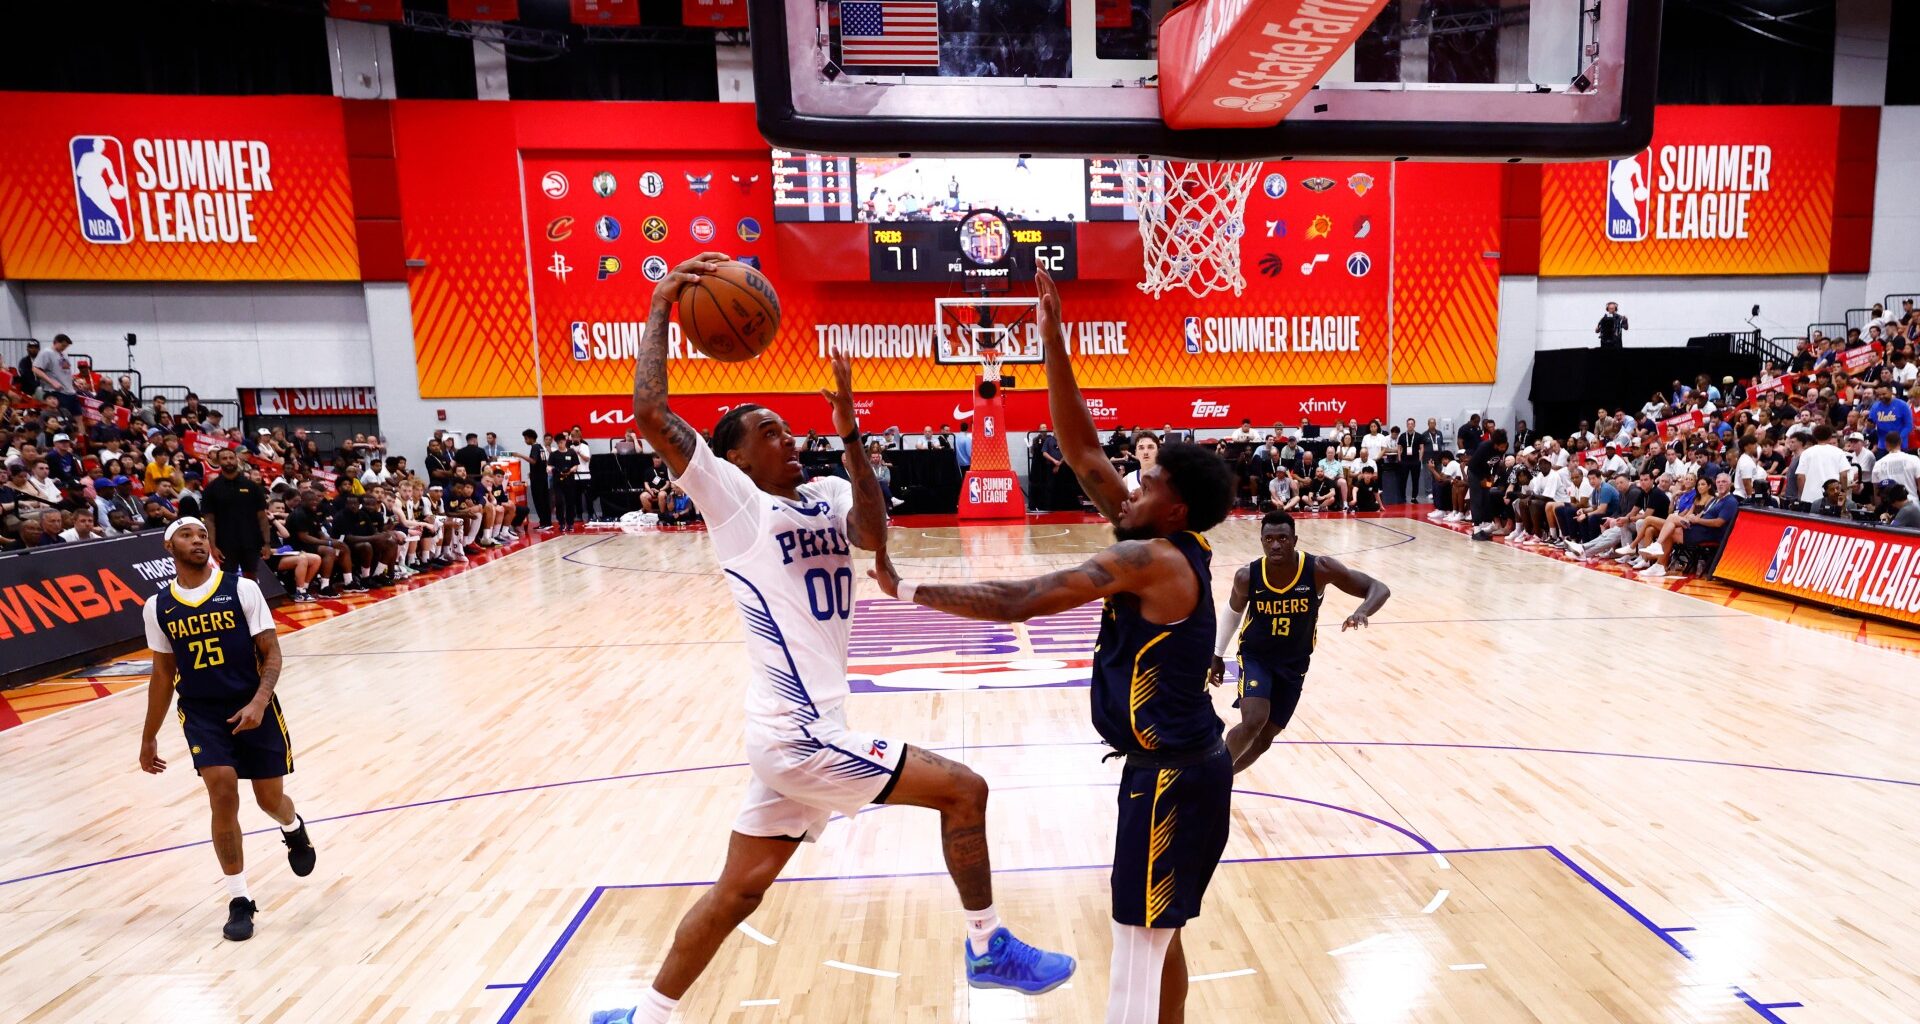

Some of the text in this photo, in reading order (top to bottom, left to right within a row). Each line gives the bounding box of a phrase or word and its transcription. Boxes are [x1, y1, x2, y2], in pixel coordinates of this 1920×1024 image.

[133, 138, 273, 191] SUMMER
[825, 161, 834, 172] 2
[840, 161, 847, 172] 1
[1658, 144, 1772, 192] SUMMER
[811, 176, 819, 188] 2
[826, 176, 835, 188] 2
[812, 192, 820, 203] 2
[827, 192, 836, 203] 3
[88, 219, 115, 236] NBA
[138, 191, 258, 243] LEAGUE
[1612, 219, 1633, 236] NBA
[1655, 193, 1751, 240] LEAGUE
[873, 230, 902, 244] 76ERS
[887, 246, 917, 271] 71
[976, 268, 1009, 277] TISSOT
[592, 322, 683, 360] SUMR
[815, 322, 952, 359] TOMORROW'S
[957, 322, 1020, 357] STRS
[1079, 320, 1129, 356] HERE
[1204, 316, 1360, 353] SUMMER LEAGUE
[294, 387, 377, 410] SUMMER
[1299, 397, 1347, 415] xfinity
[982, 477, 1013, 491] SUMMER
[982, 490, 1008, 503] LEAGUE
[775, 527, 850, 565] PHIL
[132, 556, 177, 581] THURS
[1781, 529, 1876, 600] SUMMER
[804, 567, 852, 621] 00
[1256, 598, 1309, 616] PACERS
[167, 610, 236, 640] PACERS
[1271, 617, 1290, 636] 13
[188, 637, 225, 670] 25
